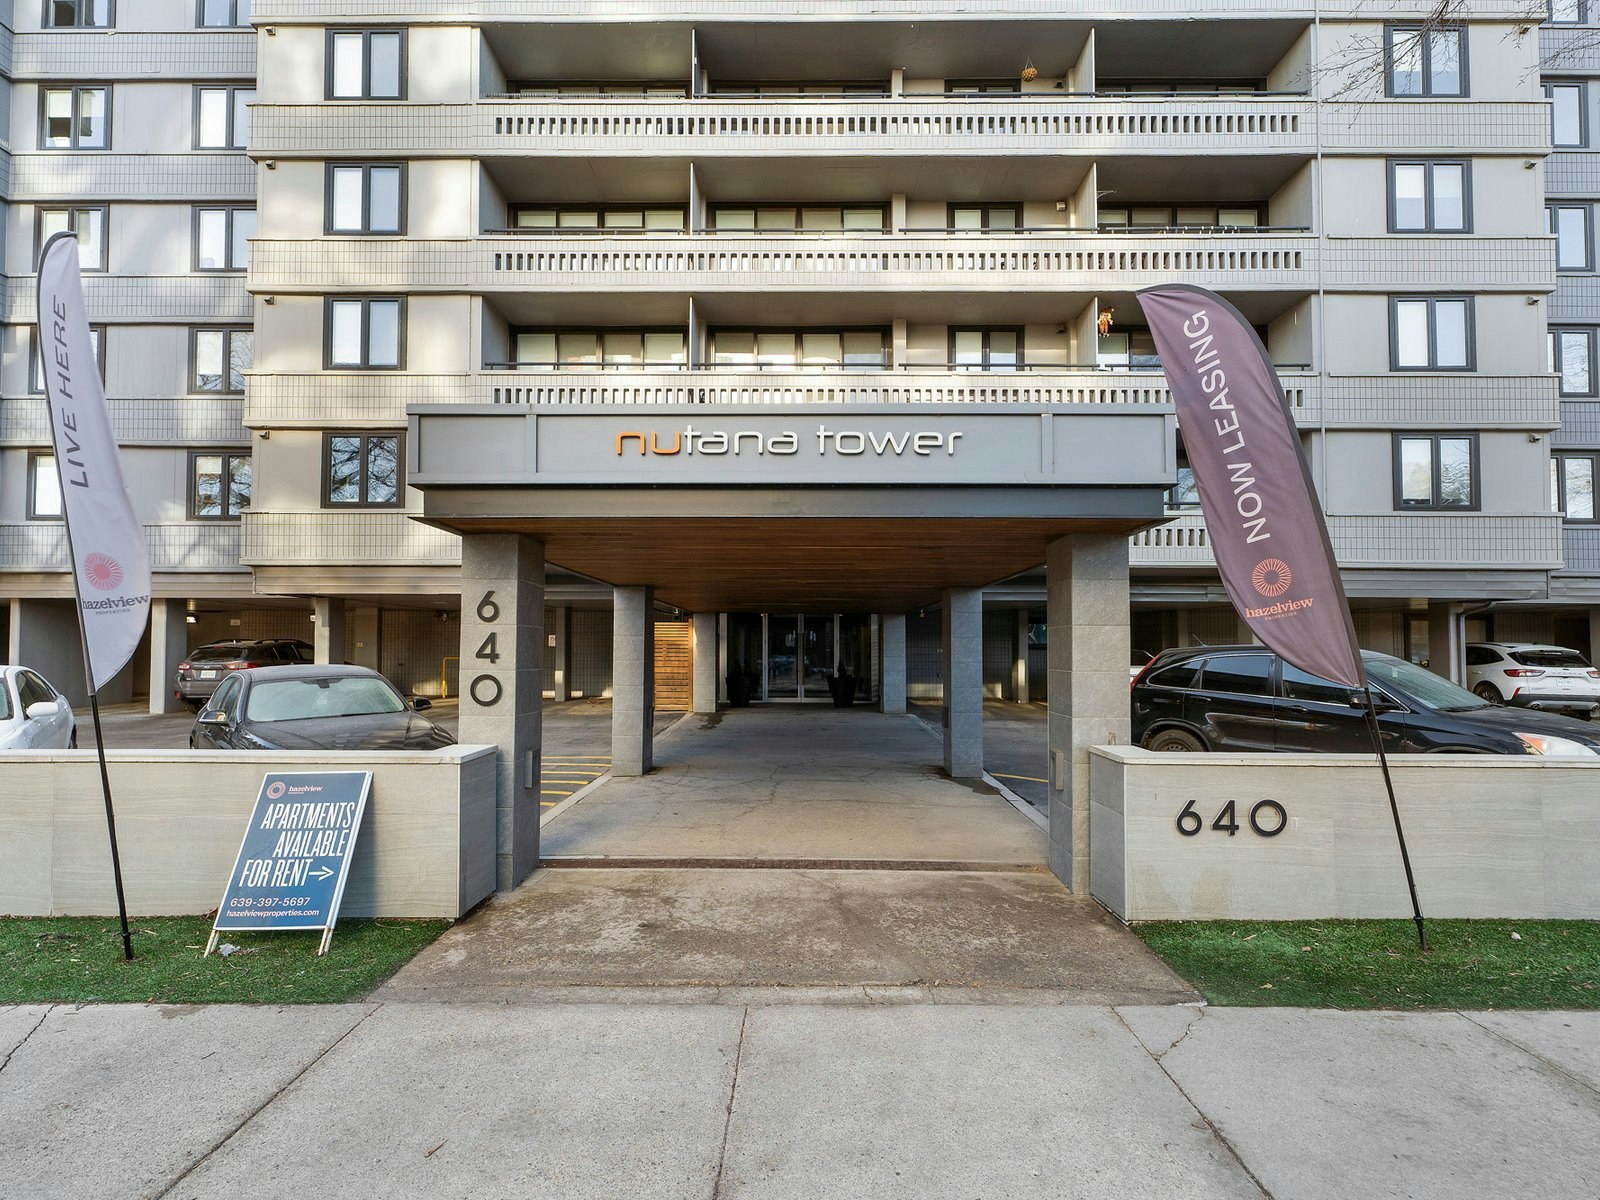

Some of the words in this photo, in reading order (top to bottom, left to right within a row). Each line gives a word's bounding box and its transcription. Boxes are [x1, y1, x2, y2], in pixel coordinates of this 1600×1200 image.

[53, 294, 73, 400] HERE
[1183, 310, 1246, 454] LEASING
[62, 407, 89, 488] LIVE
[616, 425, 798, 456] nutana
[816, 425, 963, 456] tower
[1227, 462, 1271, 544] NOW
[82, 595, 149, 610] hazelview
[1244, 598, 1313, 618] hazelview
[470, 590, 503, 707] 640
[260, 802, 356, 829] APARTMENTS
[1175, 799, 1288, 837] 640
[272, 829, 349, 858] AVAILABLE
[238, 859, 273, 887] FOR
[270, 858, 313, 887] RENT
[226, 909, 320, 918] hazelviewproperties.com
[230, 897, 311, 907] 639-397-5697
